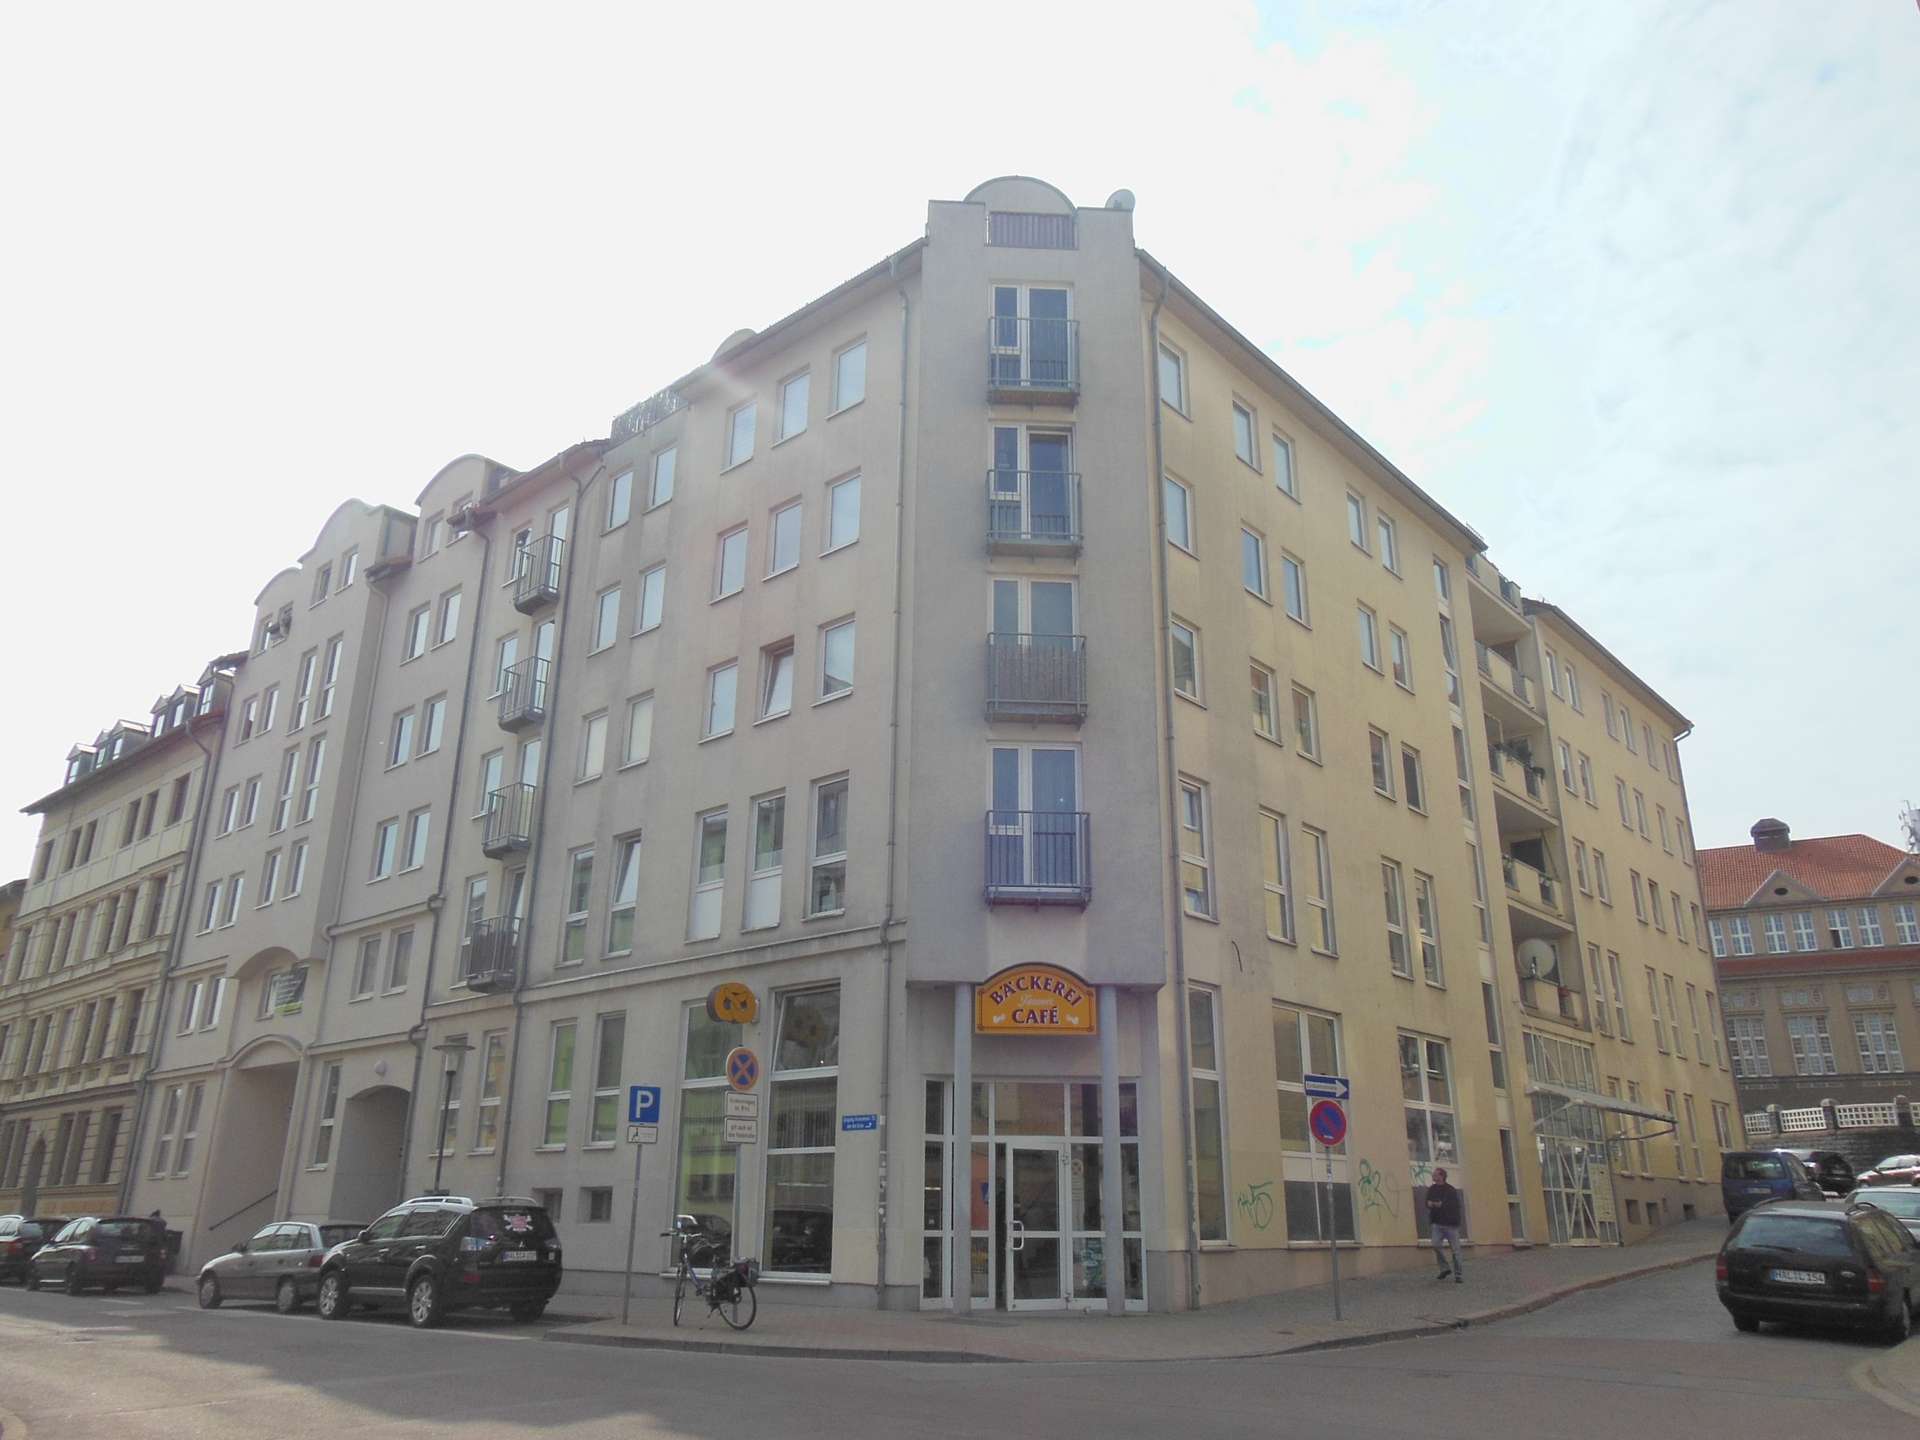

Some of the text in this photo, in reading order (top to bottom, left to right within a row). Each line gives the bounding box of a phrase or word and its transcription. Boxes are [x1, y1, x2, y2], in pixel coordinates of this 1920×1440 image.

[990, 975, 1083, 1008] BÄCKEREI
[1012, 1006, 1060, 1025] CAFÉ
[636, 1090, 654, 1118] P
